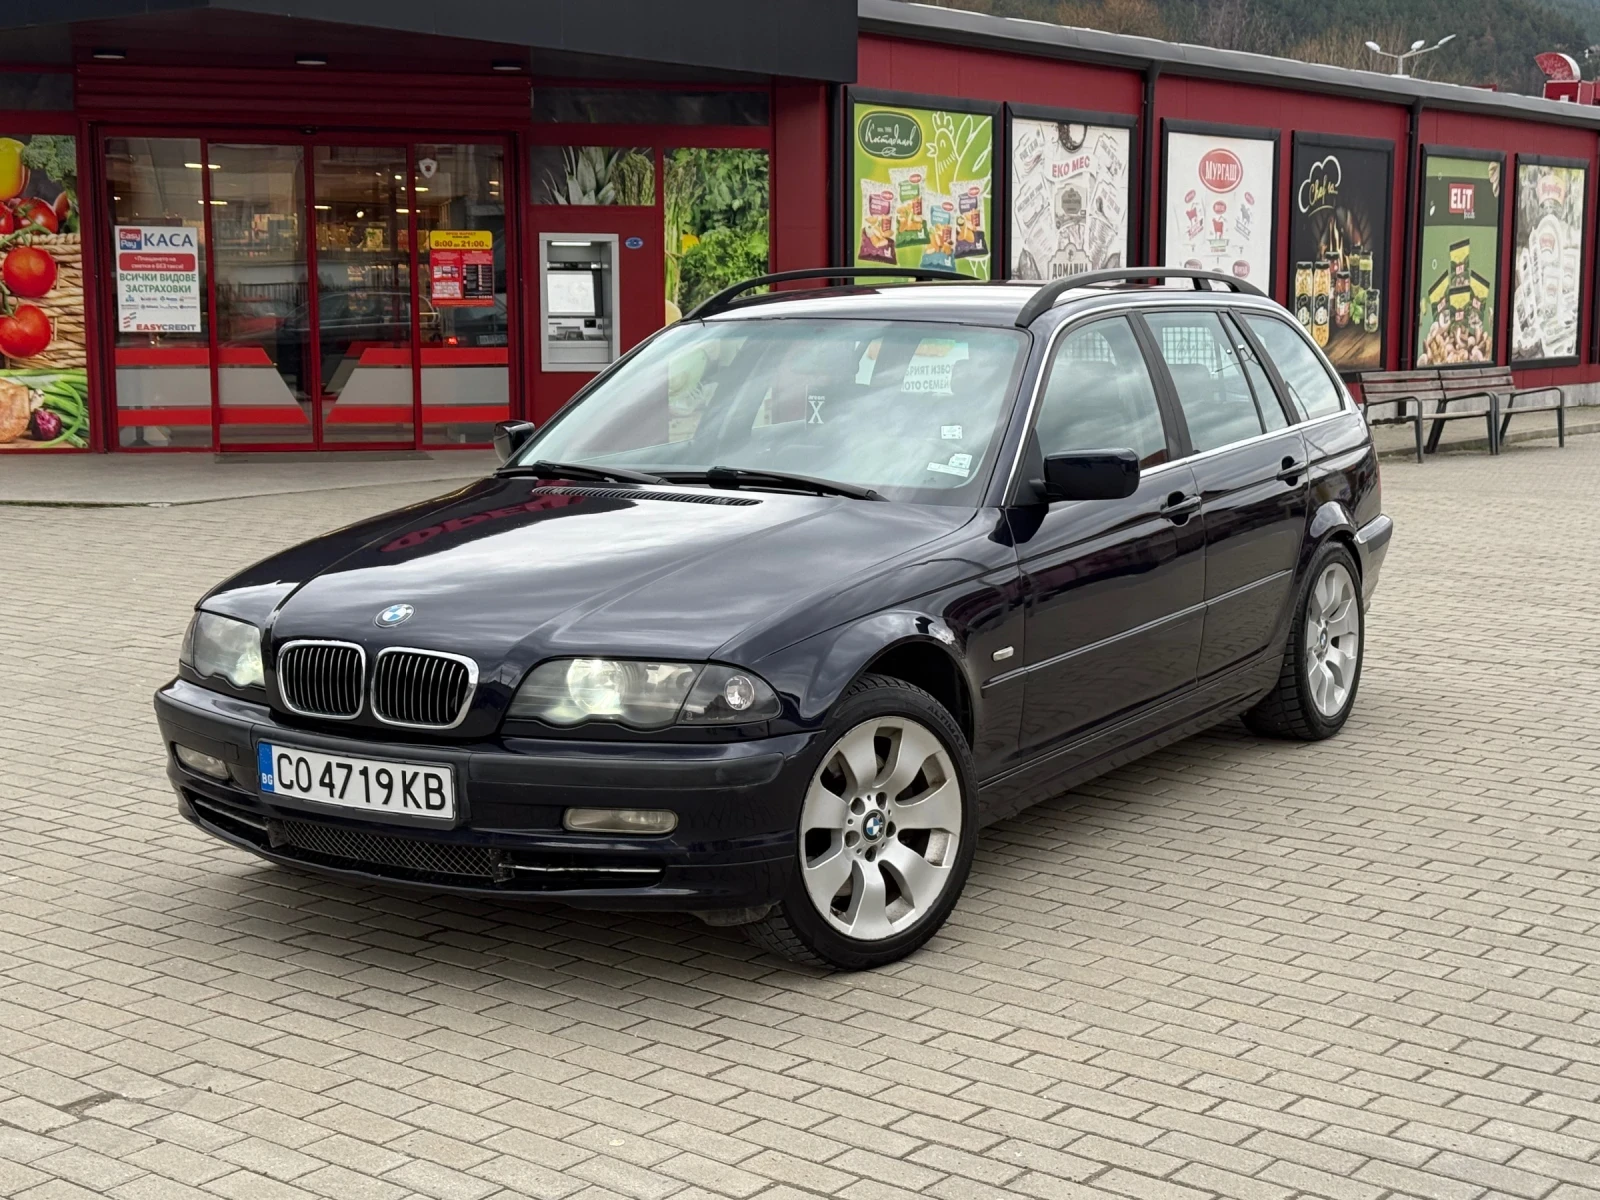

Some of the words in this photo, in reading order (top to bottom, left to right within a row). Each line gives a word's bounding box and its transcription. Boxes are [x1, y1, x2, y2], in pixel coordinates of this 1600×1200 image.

[1051, 163, 1070, 178] ЕКО
[1071, 156, 1091, 173] МЕС
[120, 232, 141, 240] Easy
[143, 233, 194, 247] КАСА
[120, 240, 137, 249] Pay
[119, 273, 158, 282] ВСИЧКИ
[159, 273, 197, 283] ВИДОВЕ
[125, 284, 192, 293] ЗАСТРАХОВКИ
[930, 364, 952, 375] ИЗБО
[903, 380, 922, 391] ОТО
[807, 400, 825, 424] X
[261, 772, 274, 785] BG
